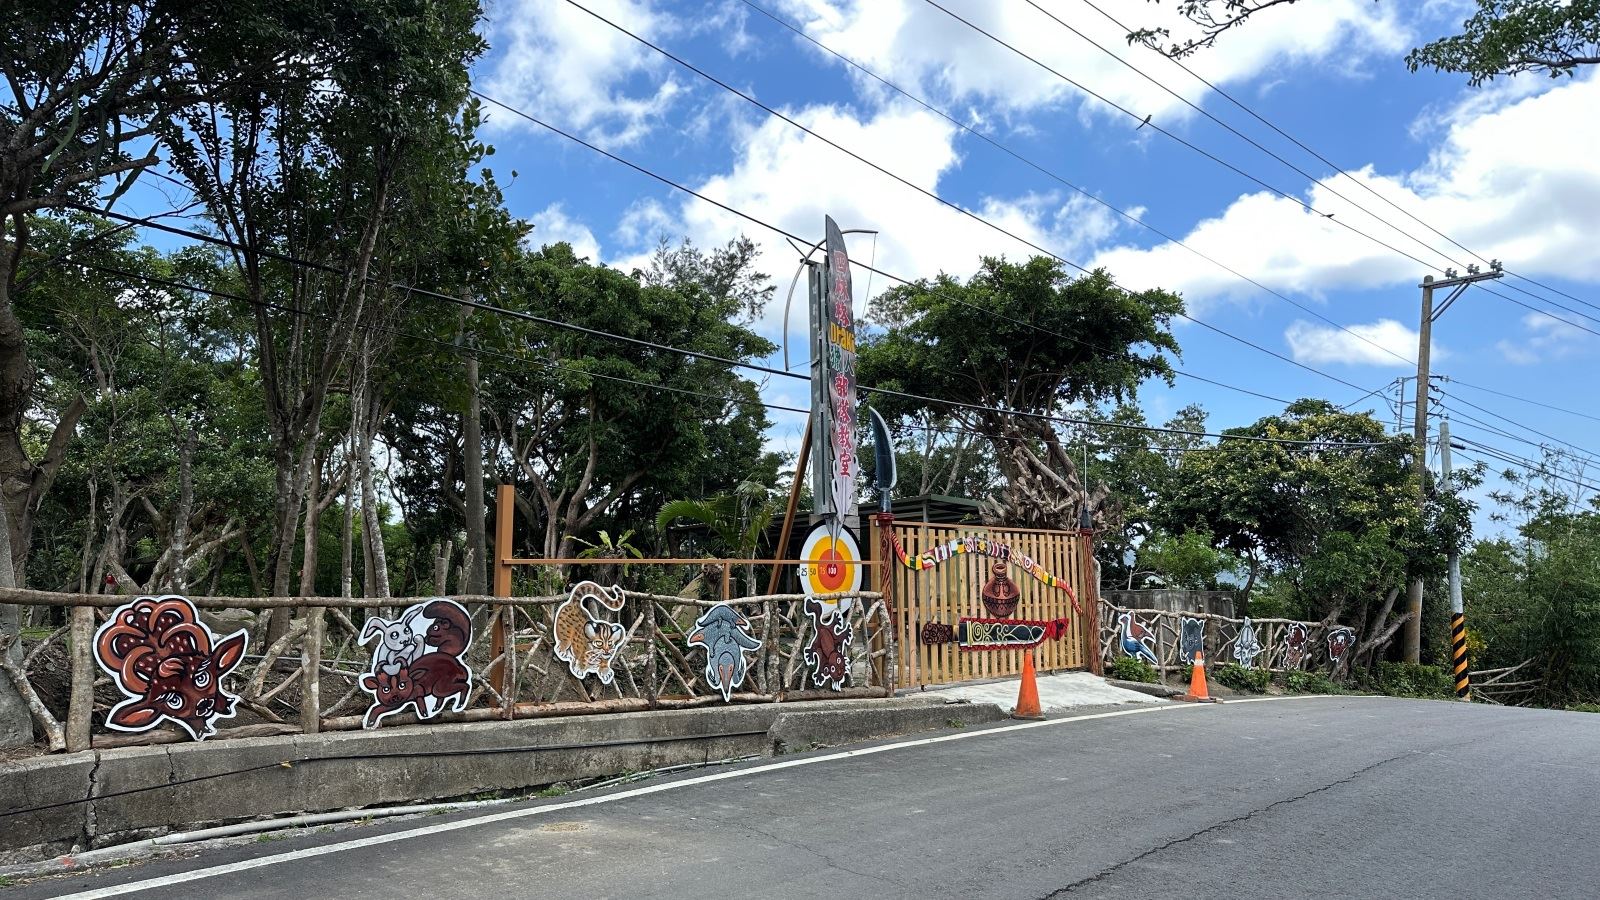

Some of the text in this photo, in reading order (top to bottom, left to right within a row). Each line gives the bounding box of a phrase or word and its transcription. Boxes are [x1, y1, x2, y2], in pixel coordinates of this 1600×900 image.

[835, 371, 852, 477] 部落教室
[801, 567, 807, 576] 25
[810, 567, 816, 576] 50
[828, 567, 837, 575] 100
